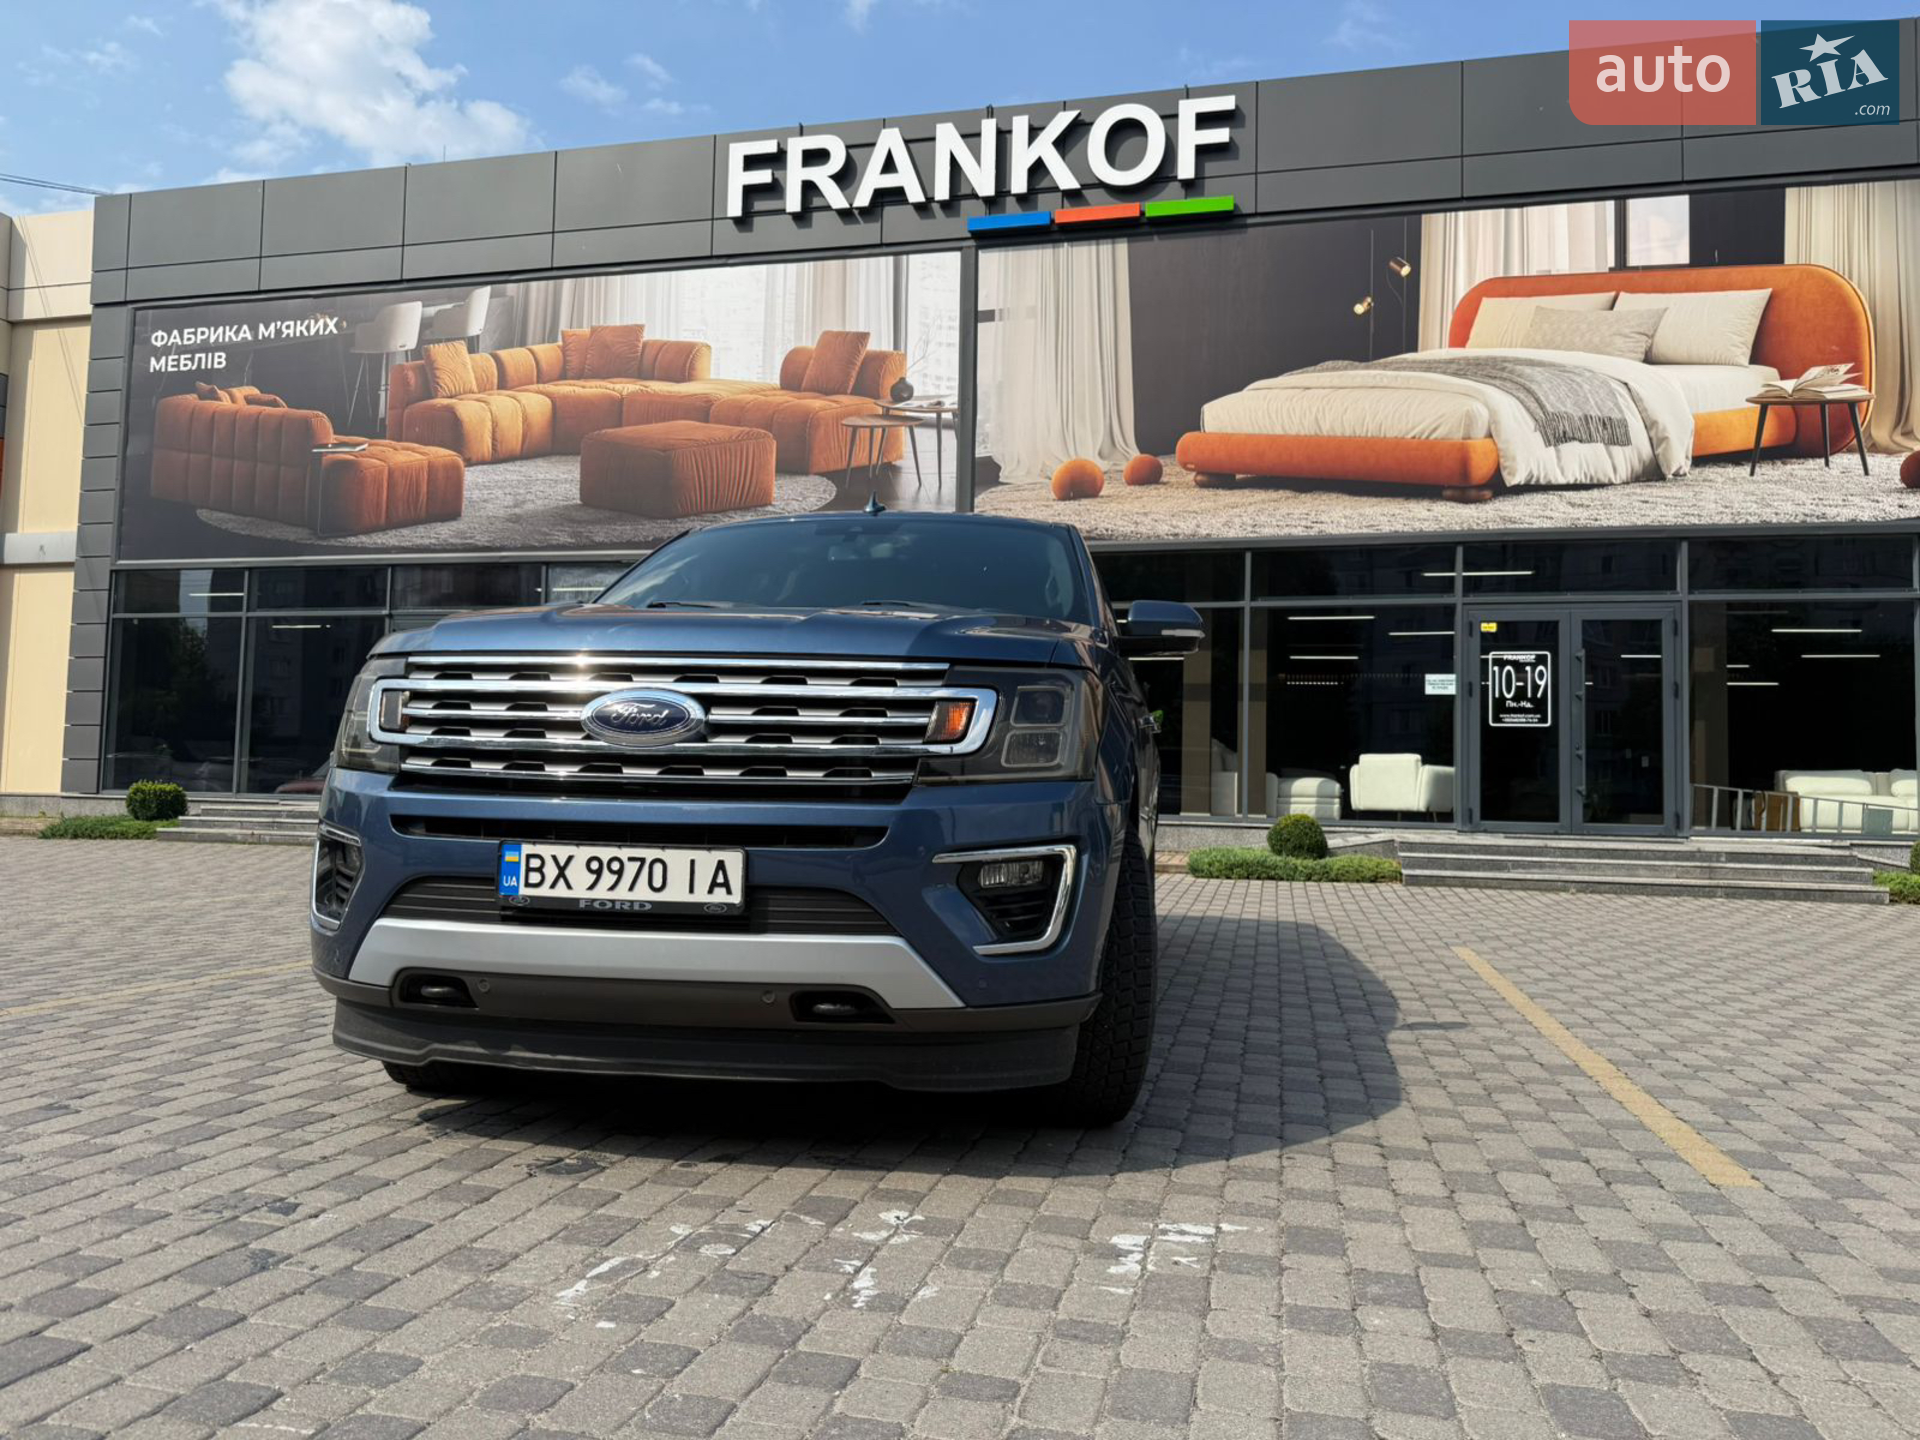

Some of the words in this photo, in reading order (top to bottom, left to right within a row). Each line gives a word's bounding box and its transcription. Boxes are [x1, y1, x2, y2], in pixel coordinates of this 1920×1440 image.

[726, 95, 1236, 218] FRANKOF
[151, 324, 252, 347] ФАБРИКА
[149, 352, 227, 373] МЕБЛІВ
[1492, 665, 1547, 699] 10-19
[611, 701, 670, 726] Ford
[503, 875, 518, 887] UA
[523, 853, 575, 890] BX
[585, 856, 668, 893] 9970
[688, 859, 733, 895] IA
[579, 898, 652, 911] FORD
